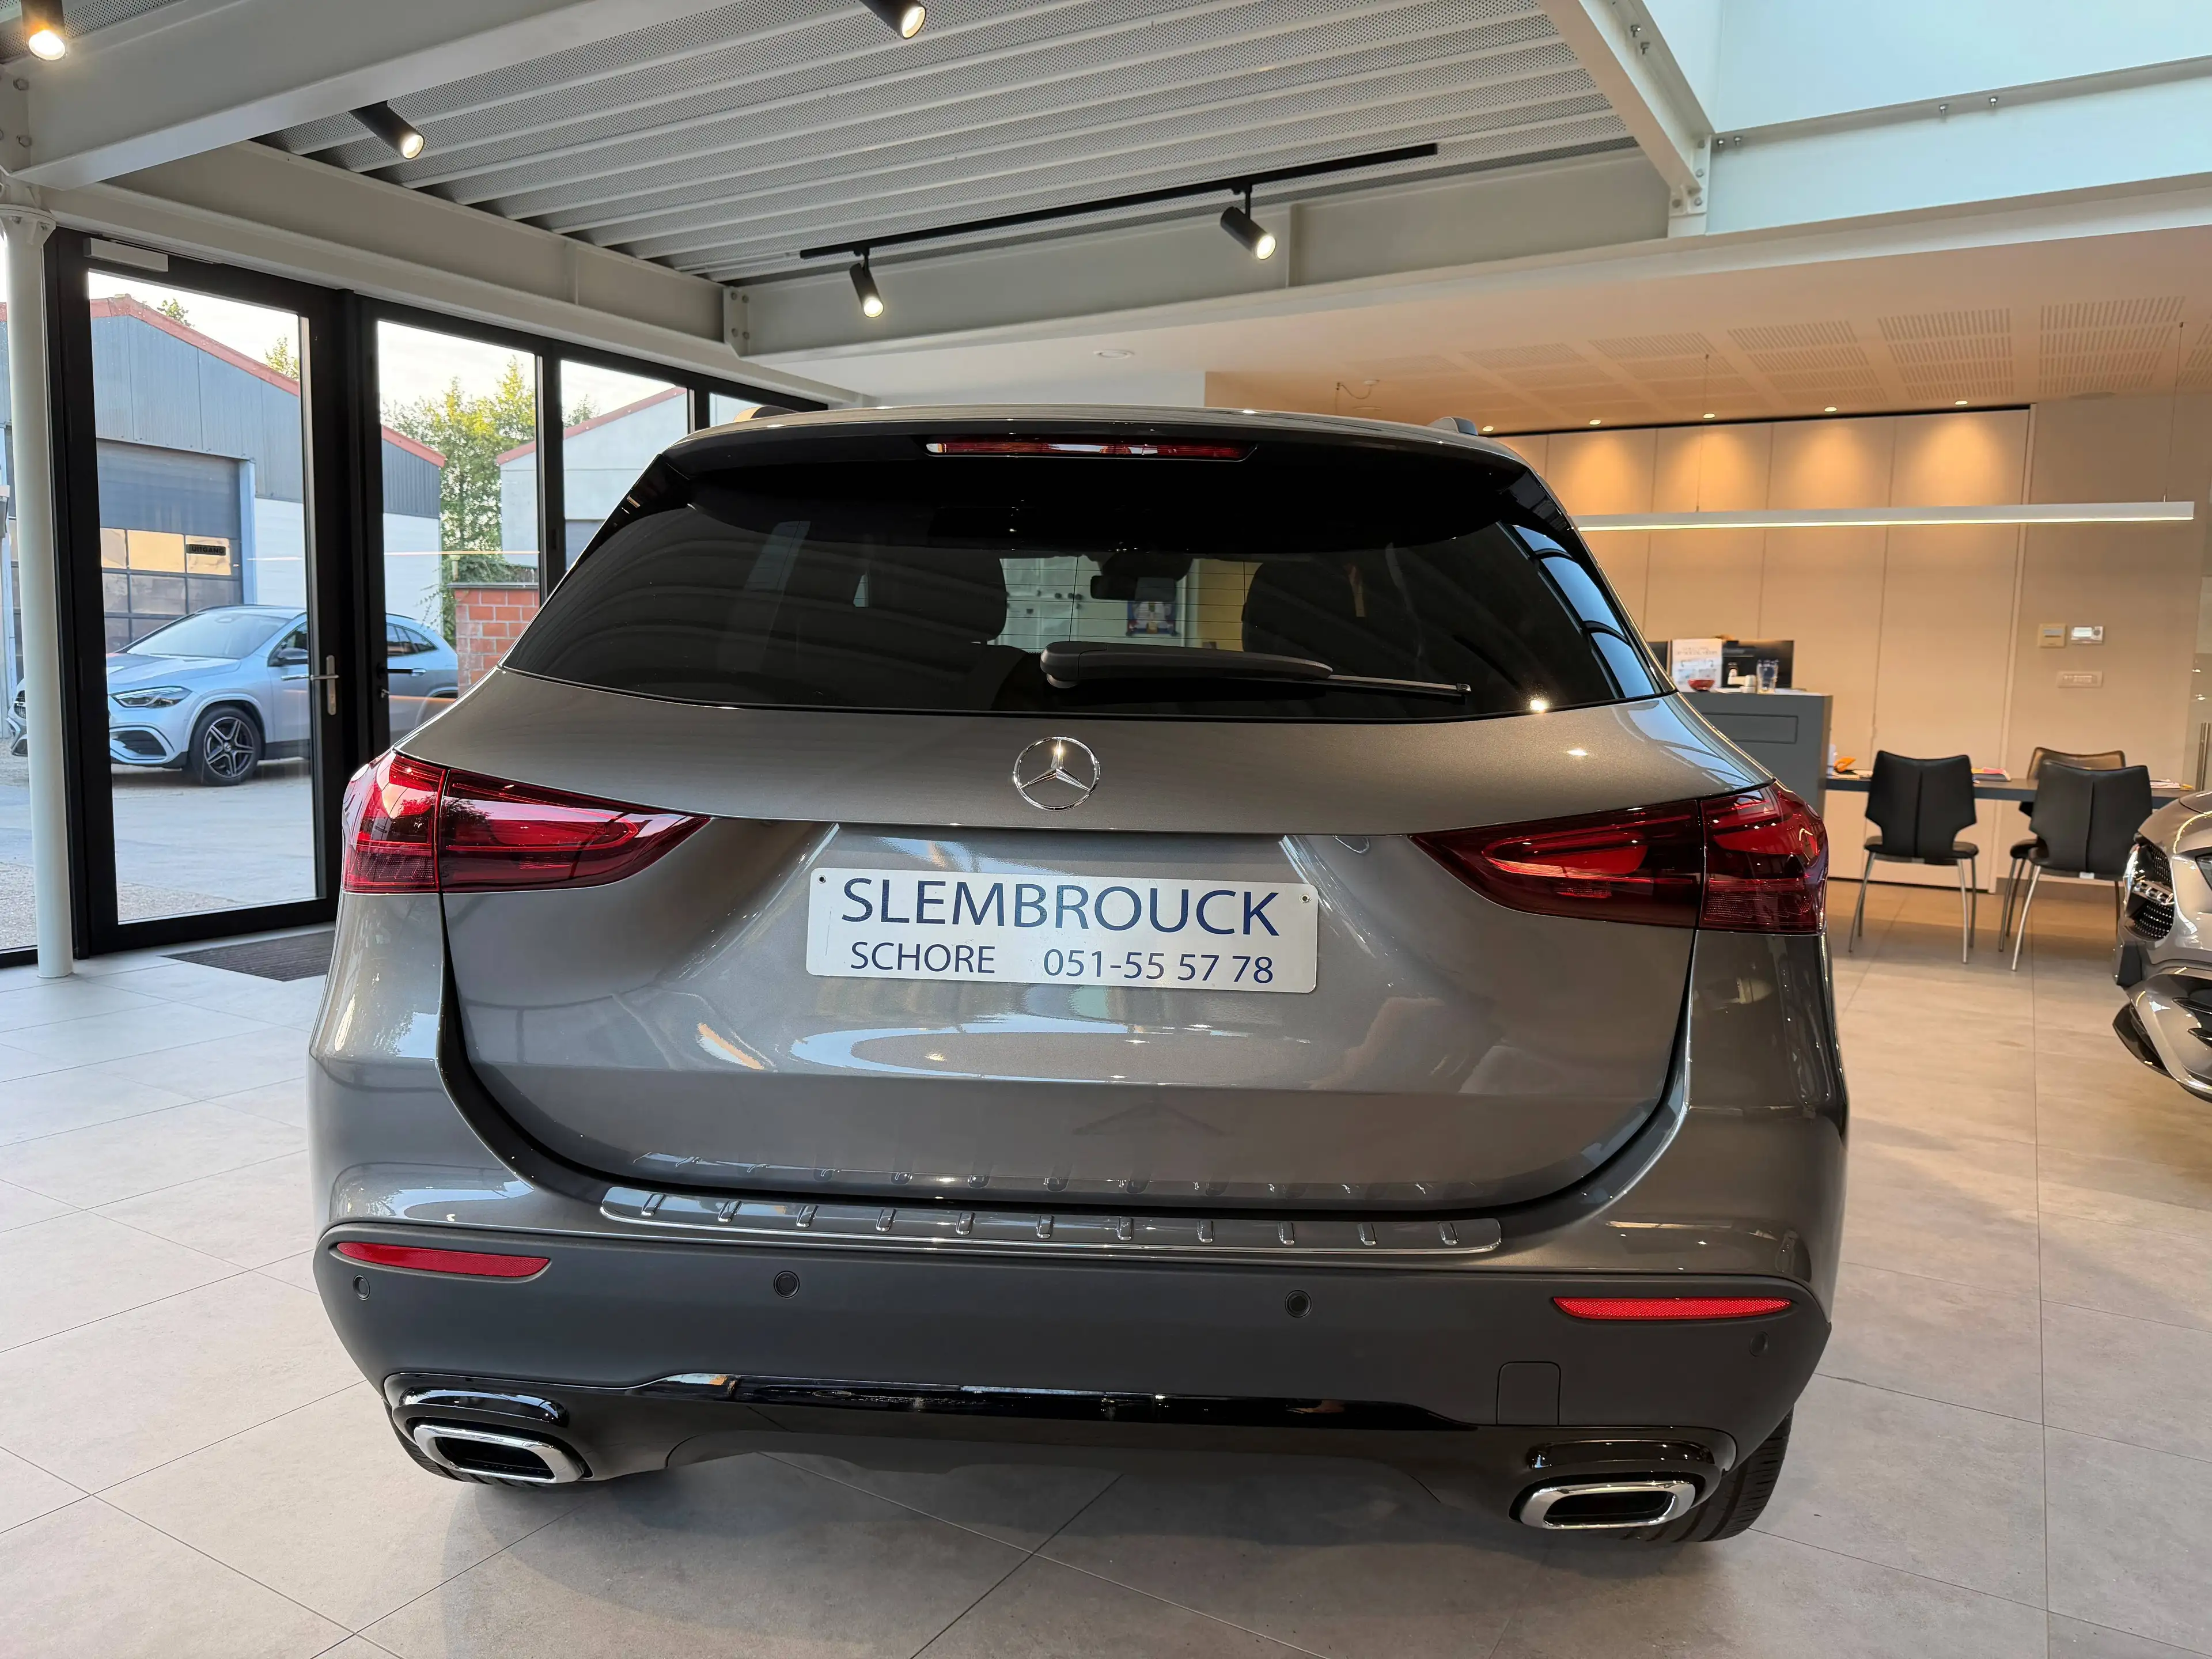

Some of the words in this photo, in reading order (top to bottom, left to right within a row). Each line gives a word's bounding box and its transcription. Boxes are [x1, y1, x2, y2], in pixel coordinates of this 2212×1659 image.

[191, 546, 224, 554] UITGANG
[842, 878, 1279, 937] SLEMBROUCK
[850, 941, 995, 974] SCHORE
[1044, 949, 1164, 980] 051-55
[1177, 953, 1219, 982] 57
[1232, 955, 1273, 984] 78
